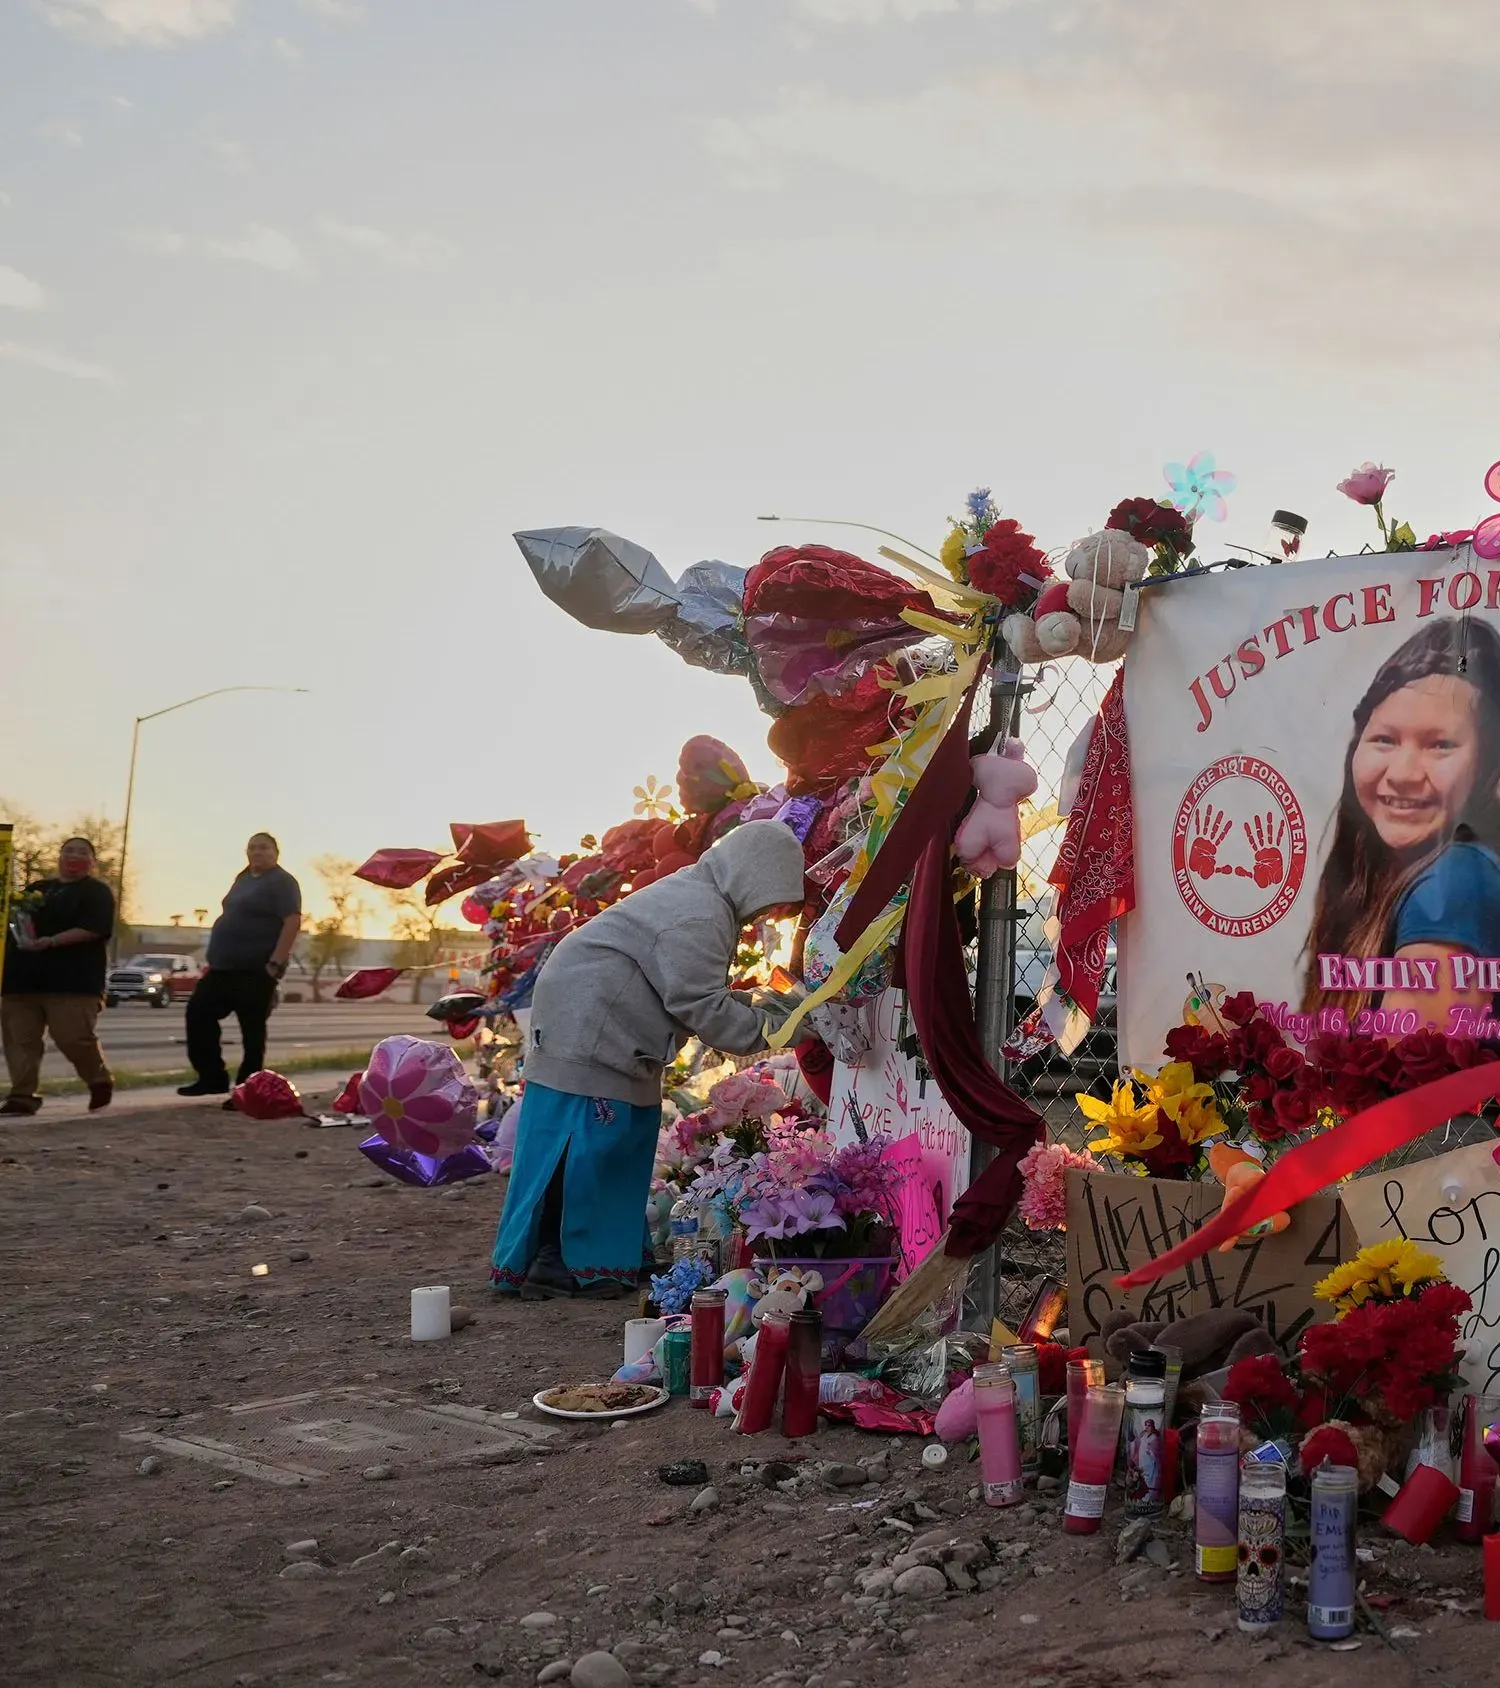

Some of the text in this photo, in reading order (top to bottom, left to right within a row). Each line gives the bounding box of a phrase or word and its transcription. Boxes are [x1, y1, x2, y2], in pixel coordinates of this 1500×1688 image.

[1188, 584, 1395, 732] JUSTICE
[1176, 759, 1304, 854] YOU ARE NOT FORGOTTEN
[1176, 869, 1295, 934] MMIW AWARENESS
[1259, 1003, 1309, 1043] May
[1360, 1010, 1417, 1034] 2010
